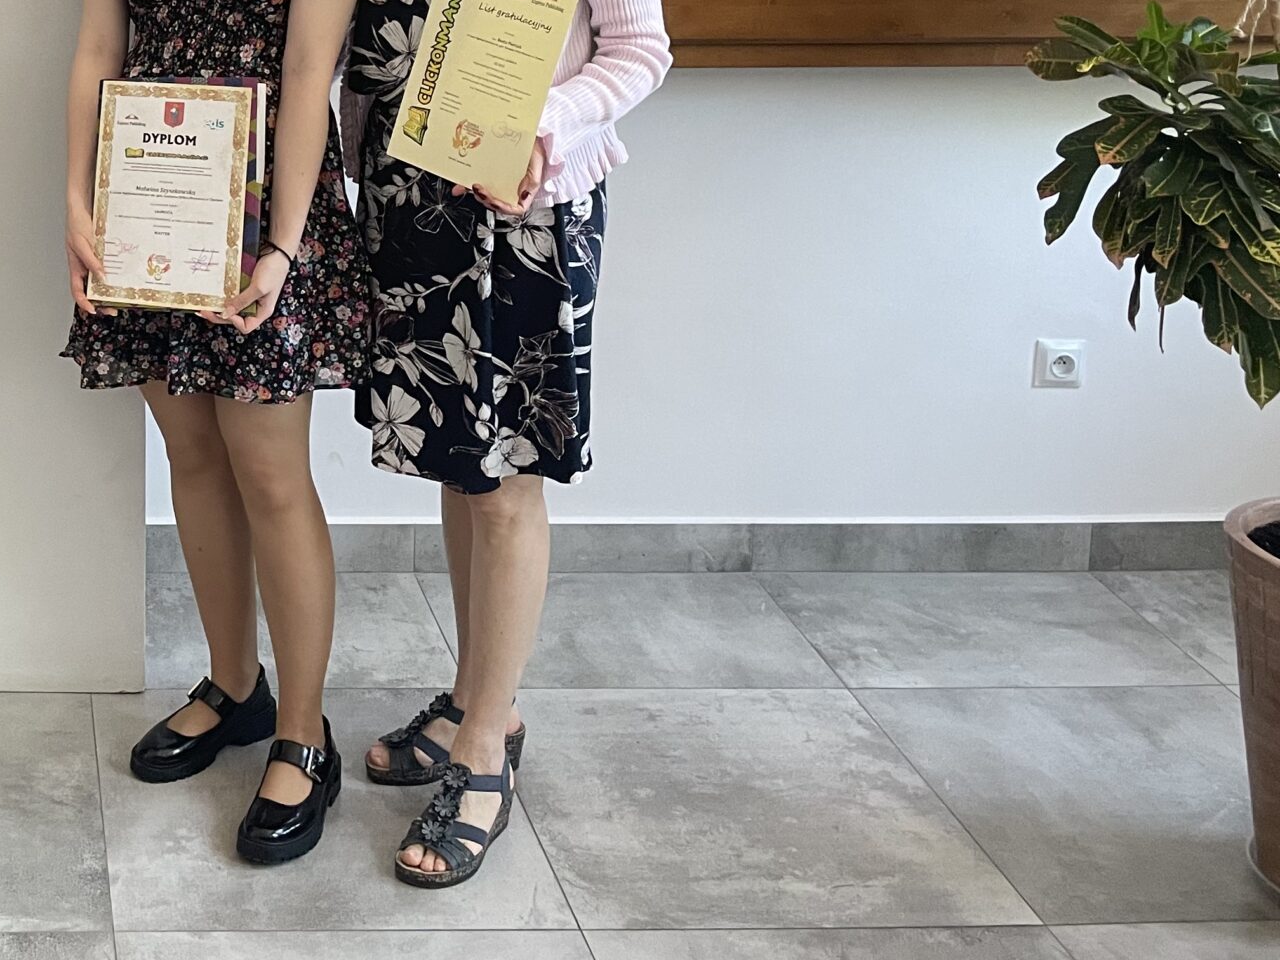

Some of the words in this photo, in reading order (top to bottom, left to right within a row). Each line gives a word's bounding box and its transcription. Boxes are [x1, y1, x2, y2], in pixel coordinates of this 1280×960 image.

[478, 2, 496, 15] List
[496, 9, 552, 33] gratulacyjny
[142, 132, 197, 146] DYPLOM
